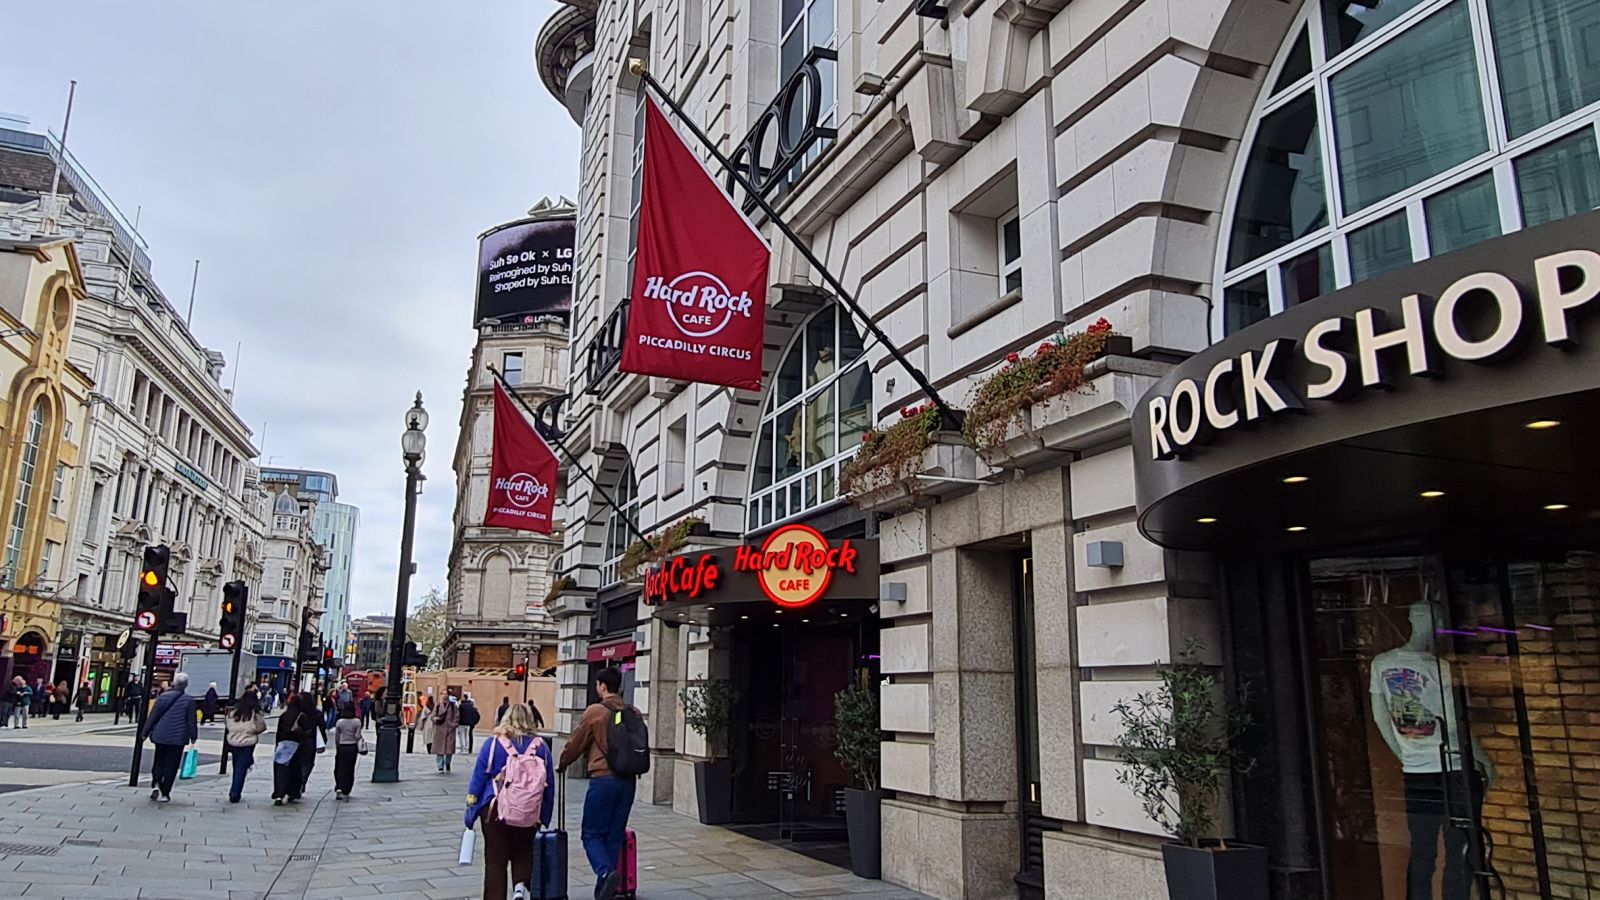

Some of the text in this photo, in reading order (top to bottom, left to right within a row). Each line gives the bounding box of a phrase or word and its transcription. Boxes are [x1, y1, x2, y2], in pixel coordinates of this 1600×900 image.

[489, 256, 505, 270] Suh
[520, 250, 536, 262] Ok
[556, 248, 572, 258] LG
[489, 262, 571, 283] Reimagined by Suh
[494, 278, 525, 293] Shaped
[527, 277, 540, 288] by
[541, 275, 559, 285] Suh
[644, 277, 752, 317] Hard Rock
[682, 314, 712, 325] CAFE
[639, 335, 751, 360] PICCADILLY CIRCUS
[1148, 249, 1600, 460] ROCK SHOP
[495, 478, 548, 498] Hard Rock
[493, 508, 546, 520] PICCADILLY CIRCUS
[733, 538, 858, 575] Hard Rock
[645, 554, 718, 605] Rock Cafe
[779, 579, 810, 591] CAFE
